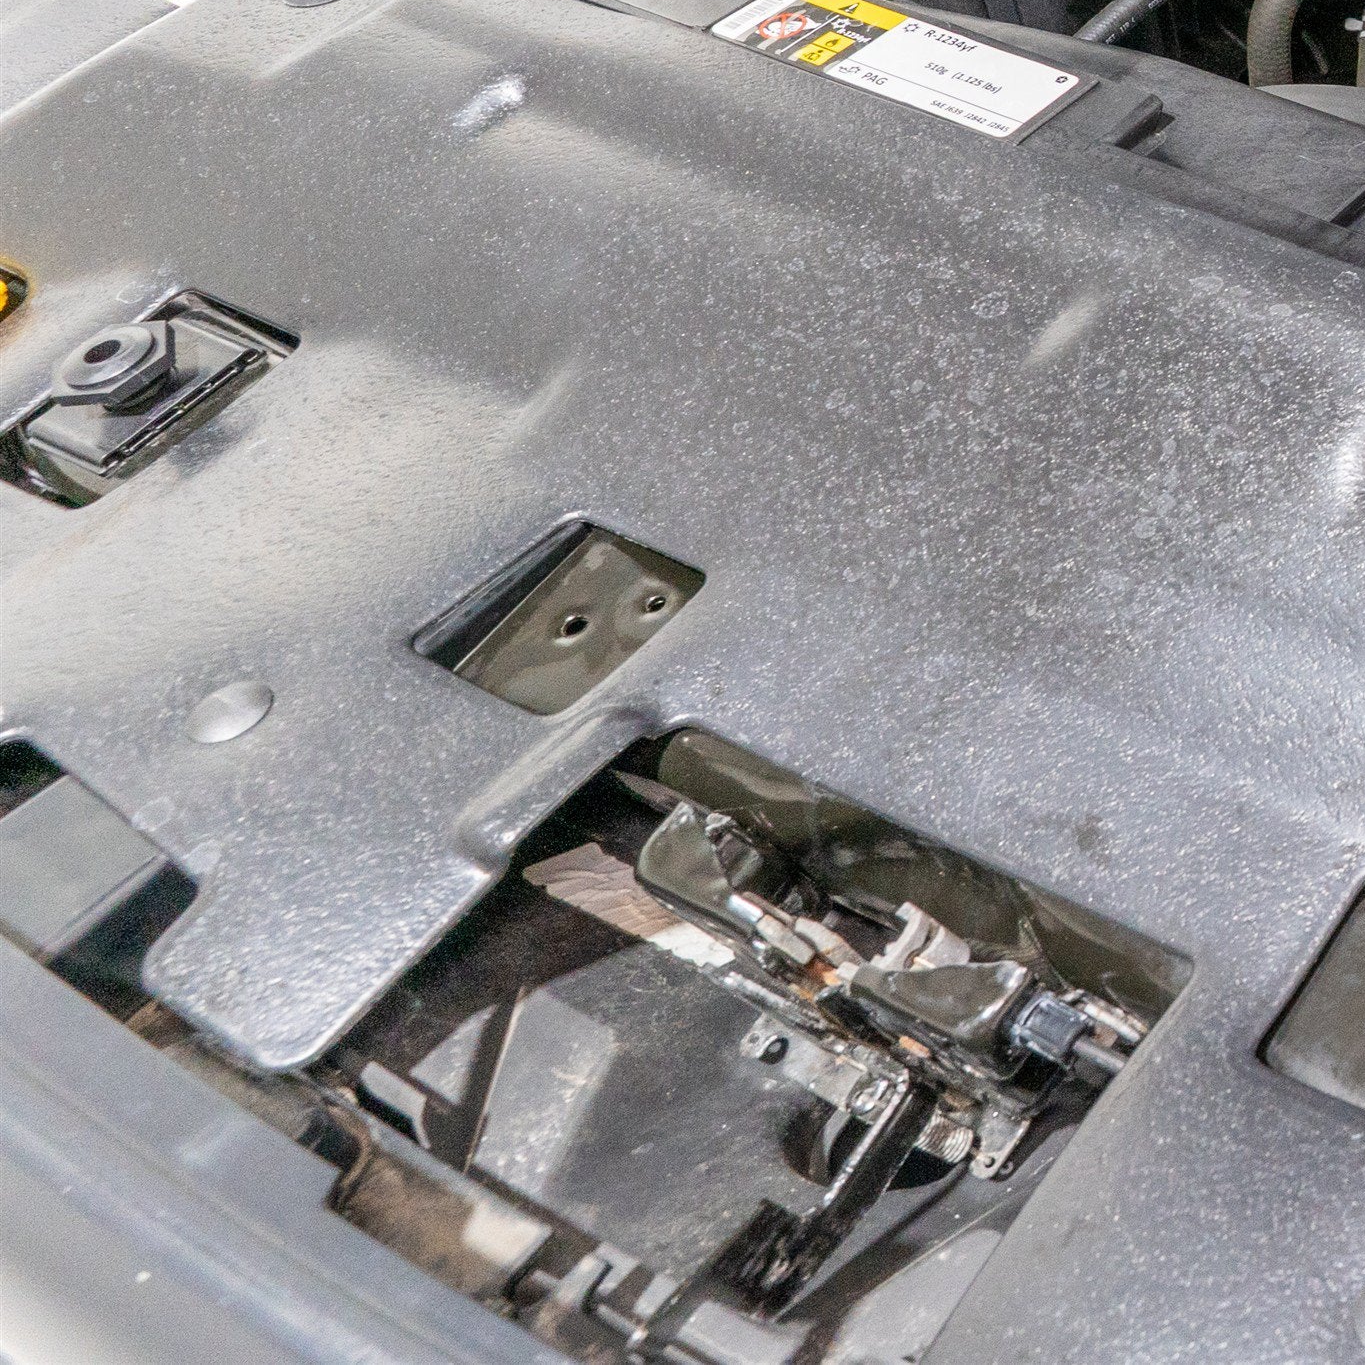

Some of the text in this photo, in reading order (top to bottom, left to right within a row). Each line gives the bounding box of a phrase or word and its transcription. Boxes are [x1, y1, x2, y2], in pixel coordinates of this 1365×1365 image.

[923, 29, 978, 54] R-1234yf
[861, 71, 888, 87] PAG
[924, 61, 1003, 95] 510g (1.125 lbs)
[930, 98, 946, 110] SAE
